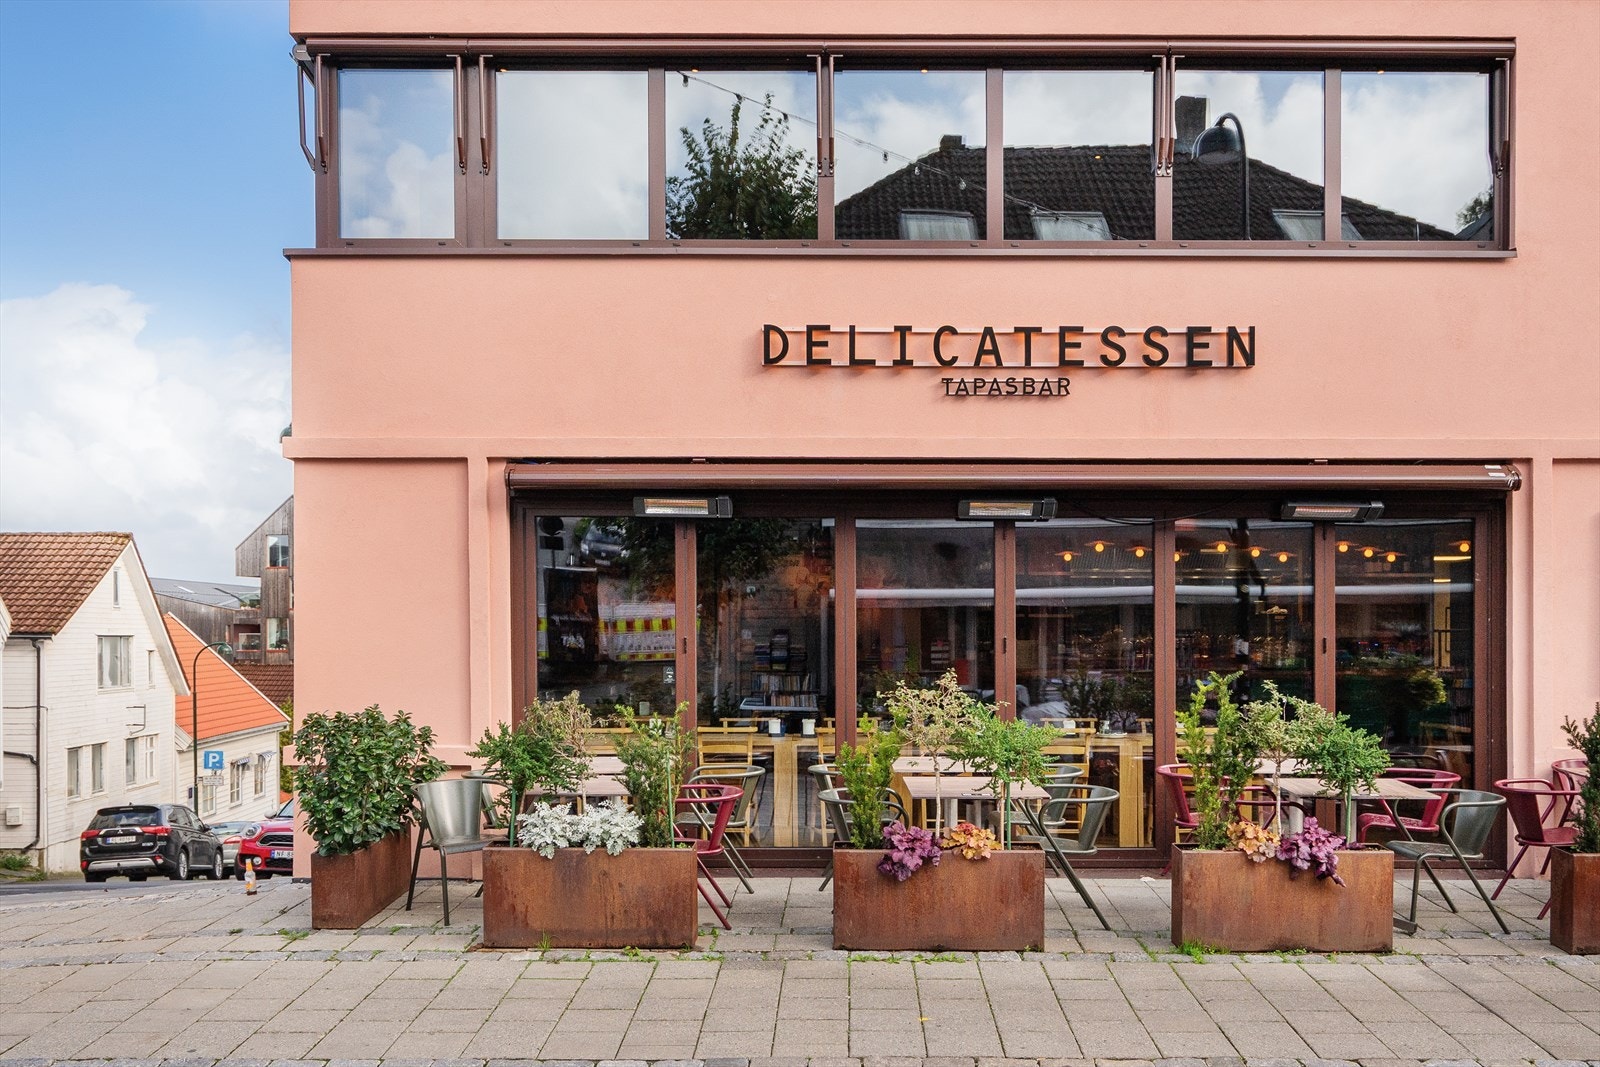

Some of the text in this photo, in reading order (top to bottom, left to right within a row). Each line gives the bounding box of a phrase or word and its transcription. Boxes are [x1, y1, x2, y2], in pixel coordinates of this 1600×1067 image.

[762, 324, 1255, 368] DELICATESSEN
[941, 377, 1070, 396] TAPASBAR
[208, 752, 220, 768] P
